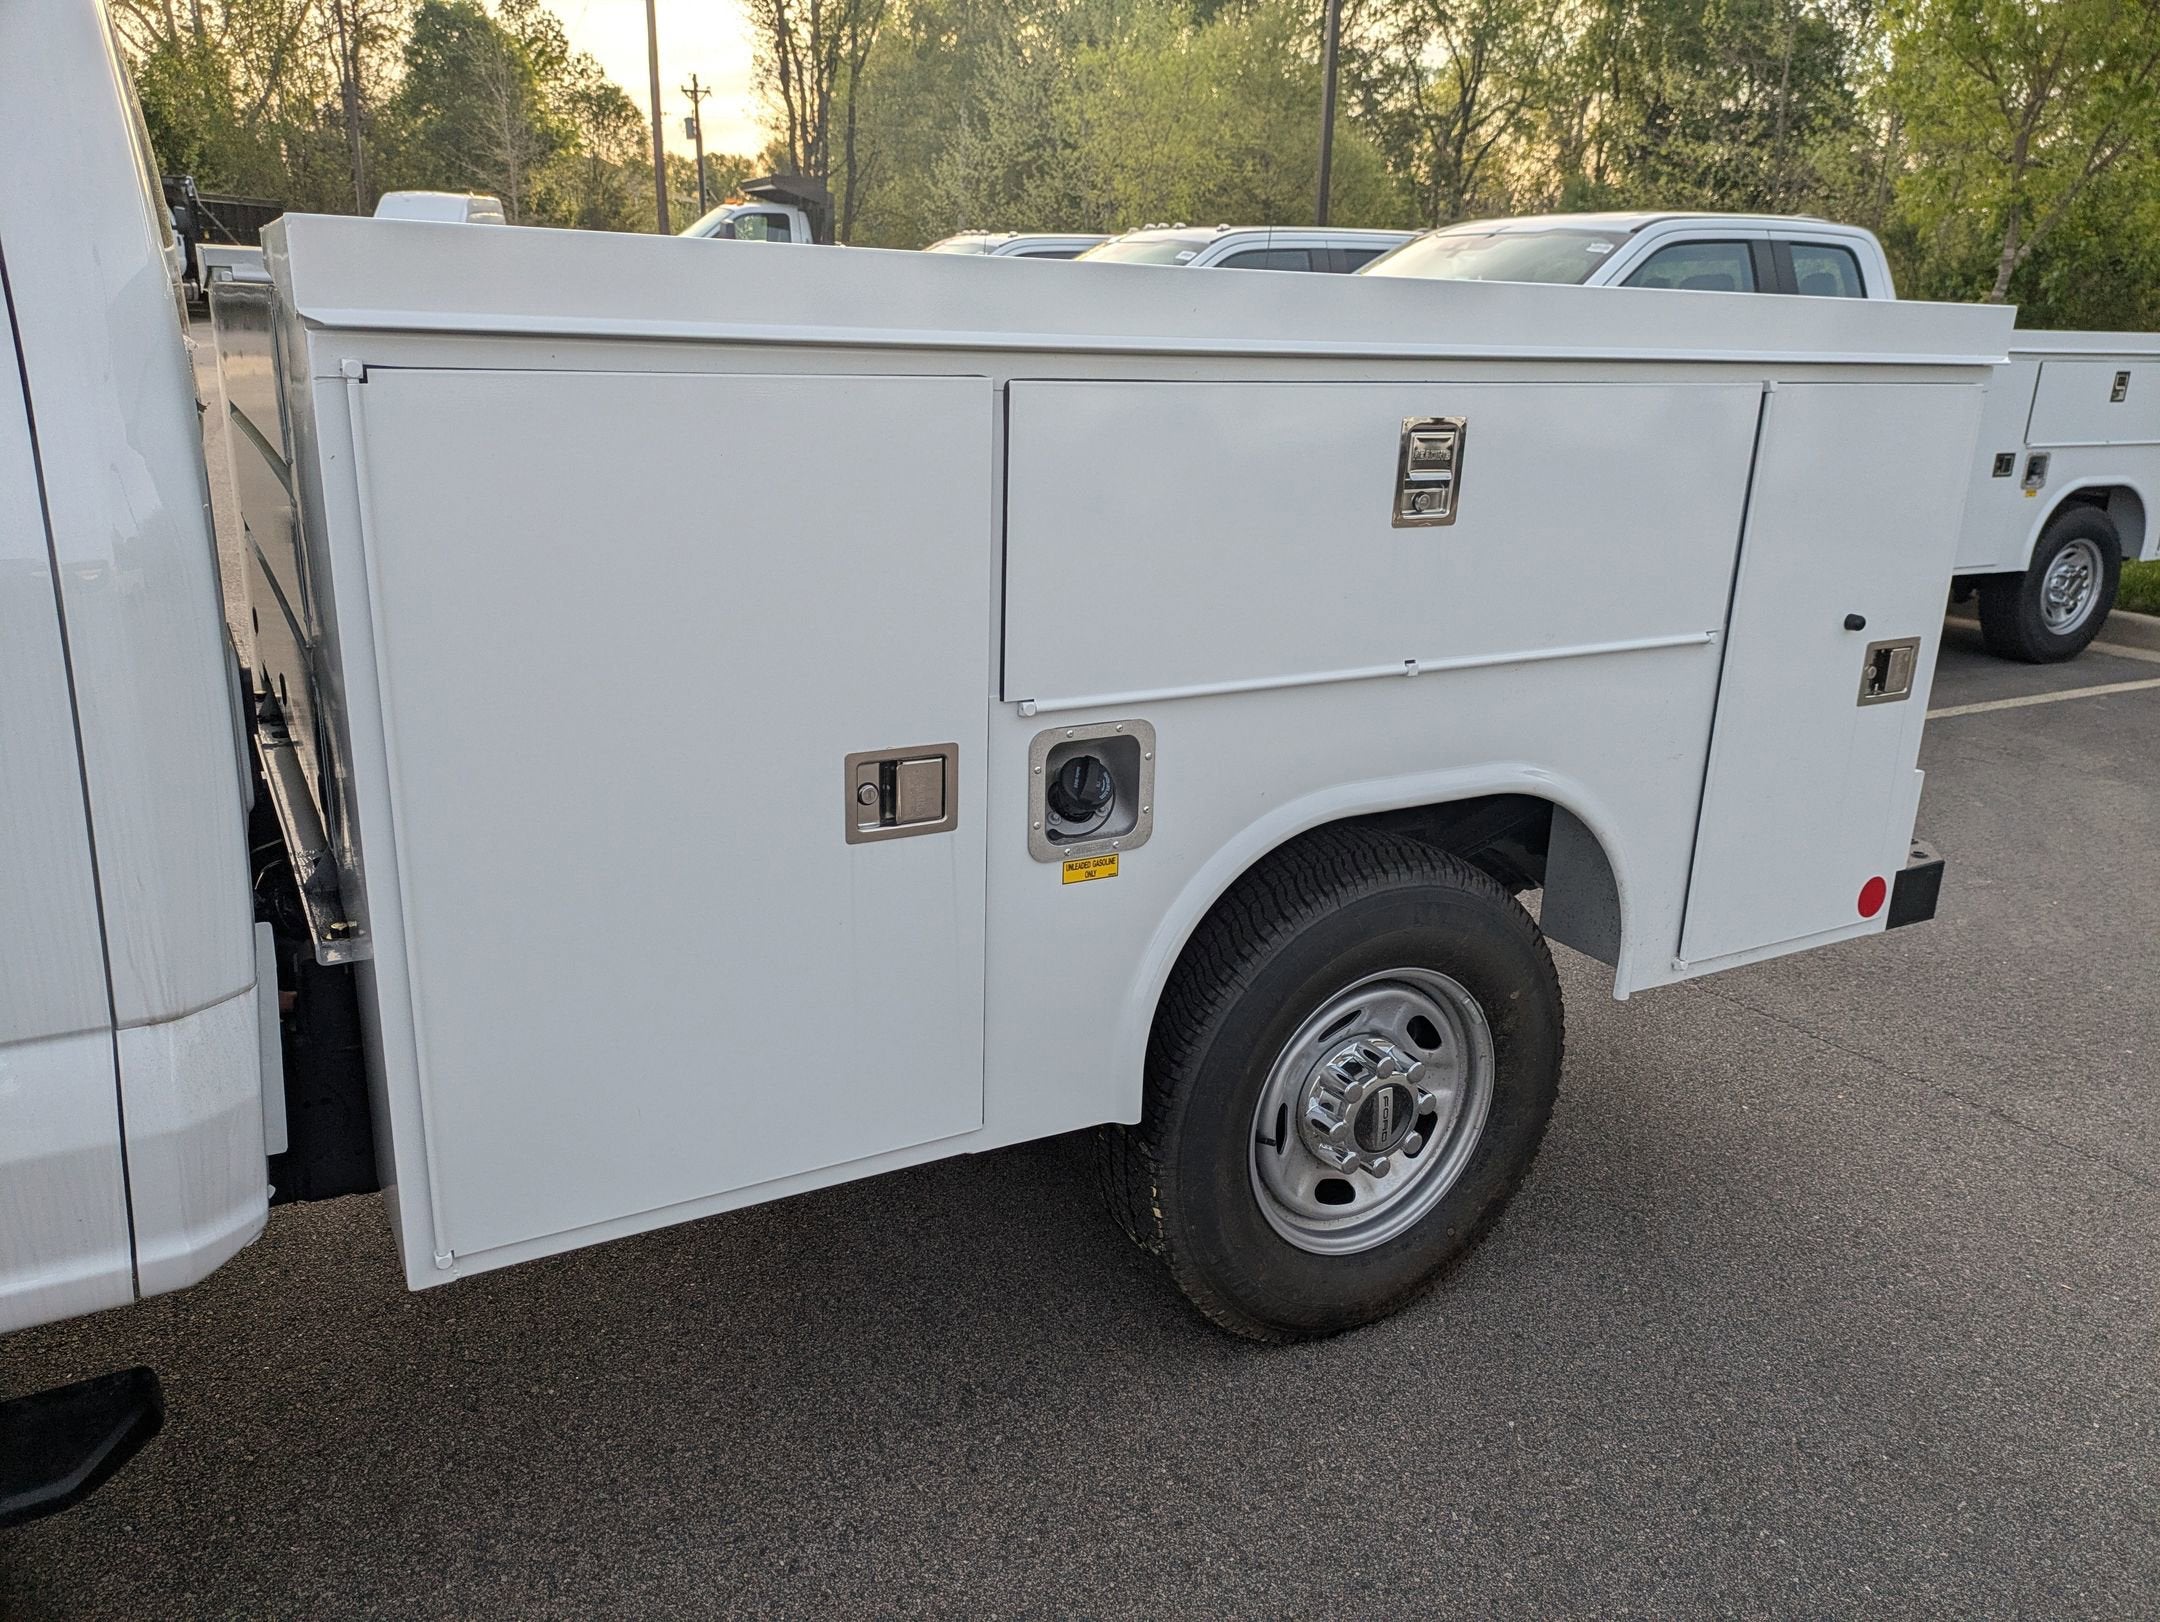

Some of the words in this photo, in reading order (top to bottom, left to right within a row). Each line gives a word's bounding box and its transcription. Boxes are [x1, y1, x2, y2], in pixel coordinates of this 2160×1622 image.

[1065, 860, 1092, 872] UNLEADED
[1092, 856, 1117, 868] GASOLINE
[1084, 870, 1097, 878] ONLY
[1381, 1096, 1389, 1142] FORD
